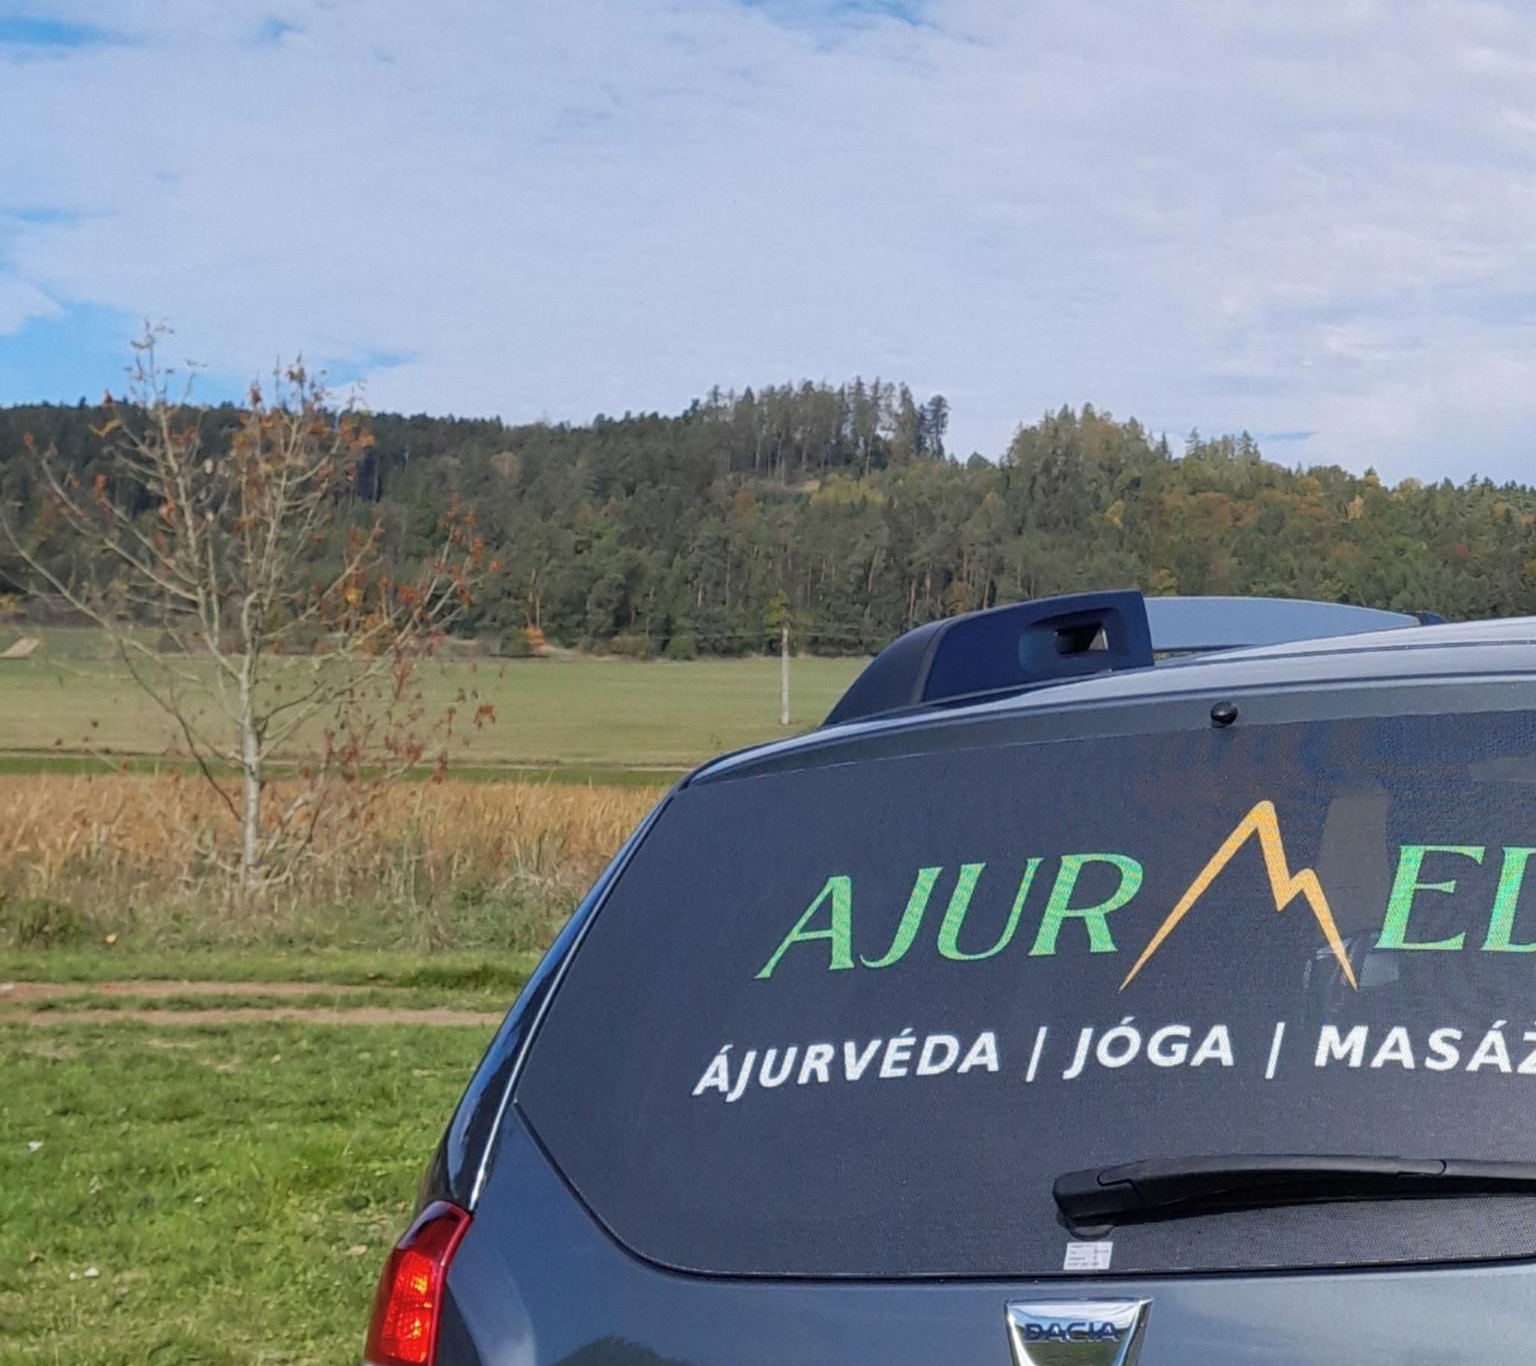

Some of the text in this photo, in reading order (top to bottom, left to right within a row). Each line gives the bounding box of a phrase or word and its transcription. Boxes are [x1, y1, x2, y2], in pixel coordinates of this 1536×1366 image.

[692, 1028, 999, 1102] ÁJURVÉDA
[1064, 1016, 1235, 1079] JÓGA
[1024, 1321, 1120, 1343] DACIA
